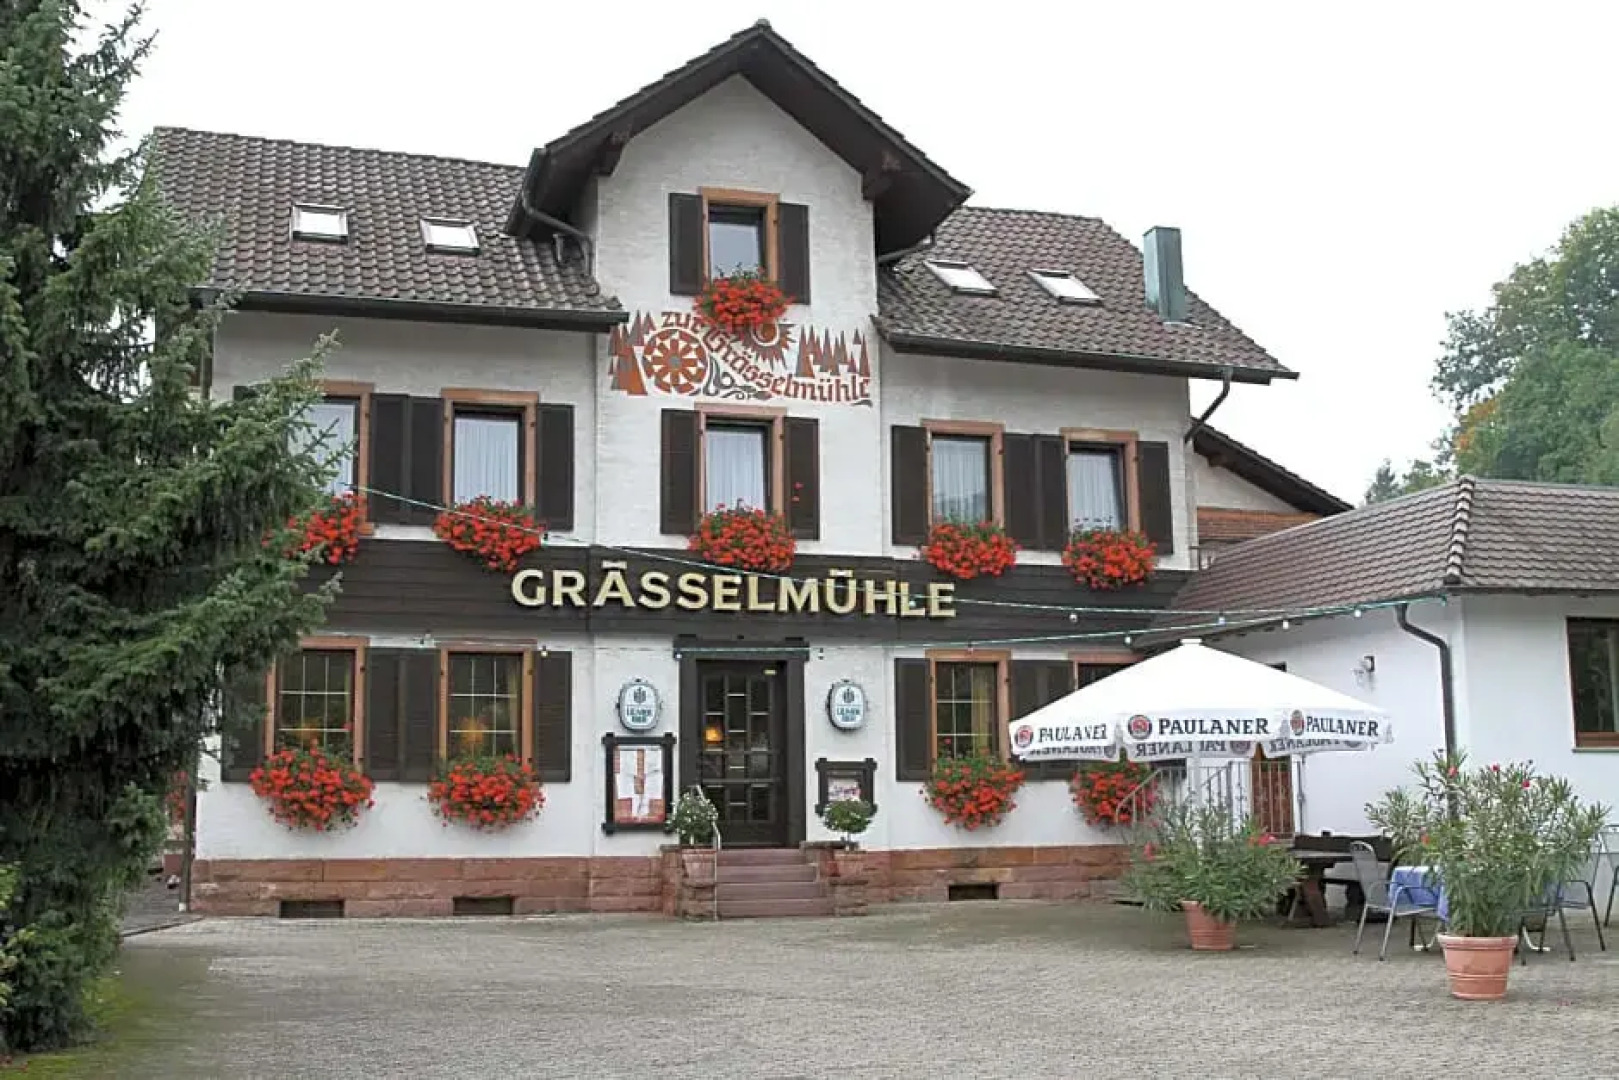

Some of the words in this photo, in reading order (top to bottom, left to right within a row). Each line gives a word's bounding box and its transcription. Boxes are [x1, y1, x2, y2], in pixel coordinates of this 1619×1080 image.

[511, 560, 957, 618] GRÄSSELMÜHLE
[1158, 717, 1269, 735] PAULANER
[1306, 716, 1379, 737] PAULANER
